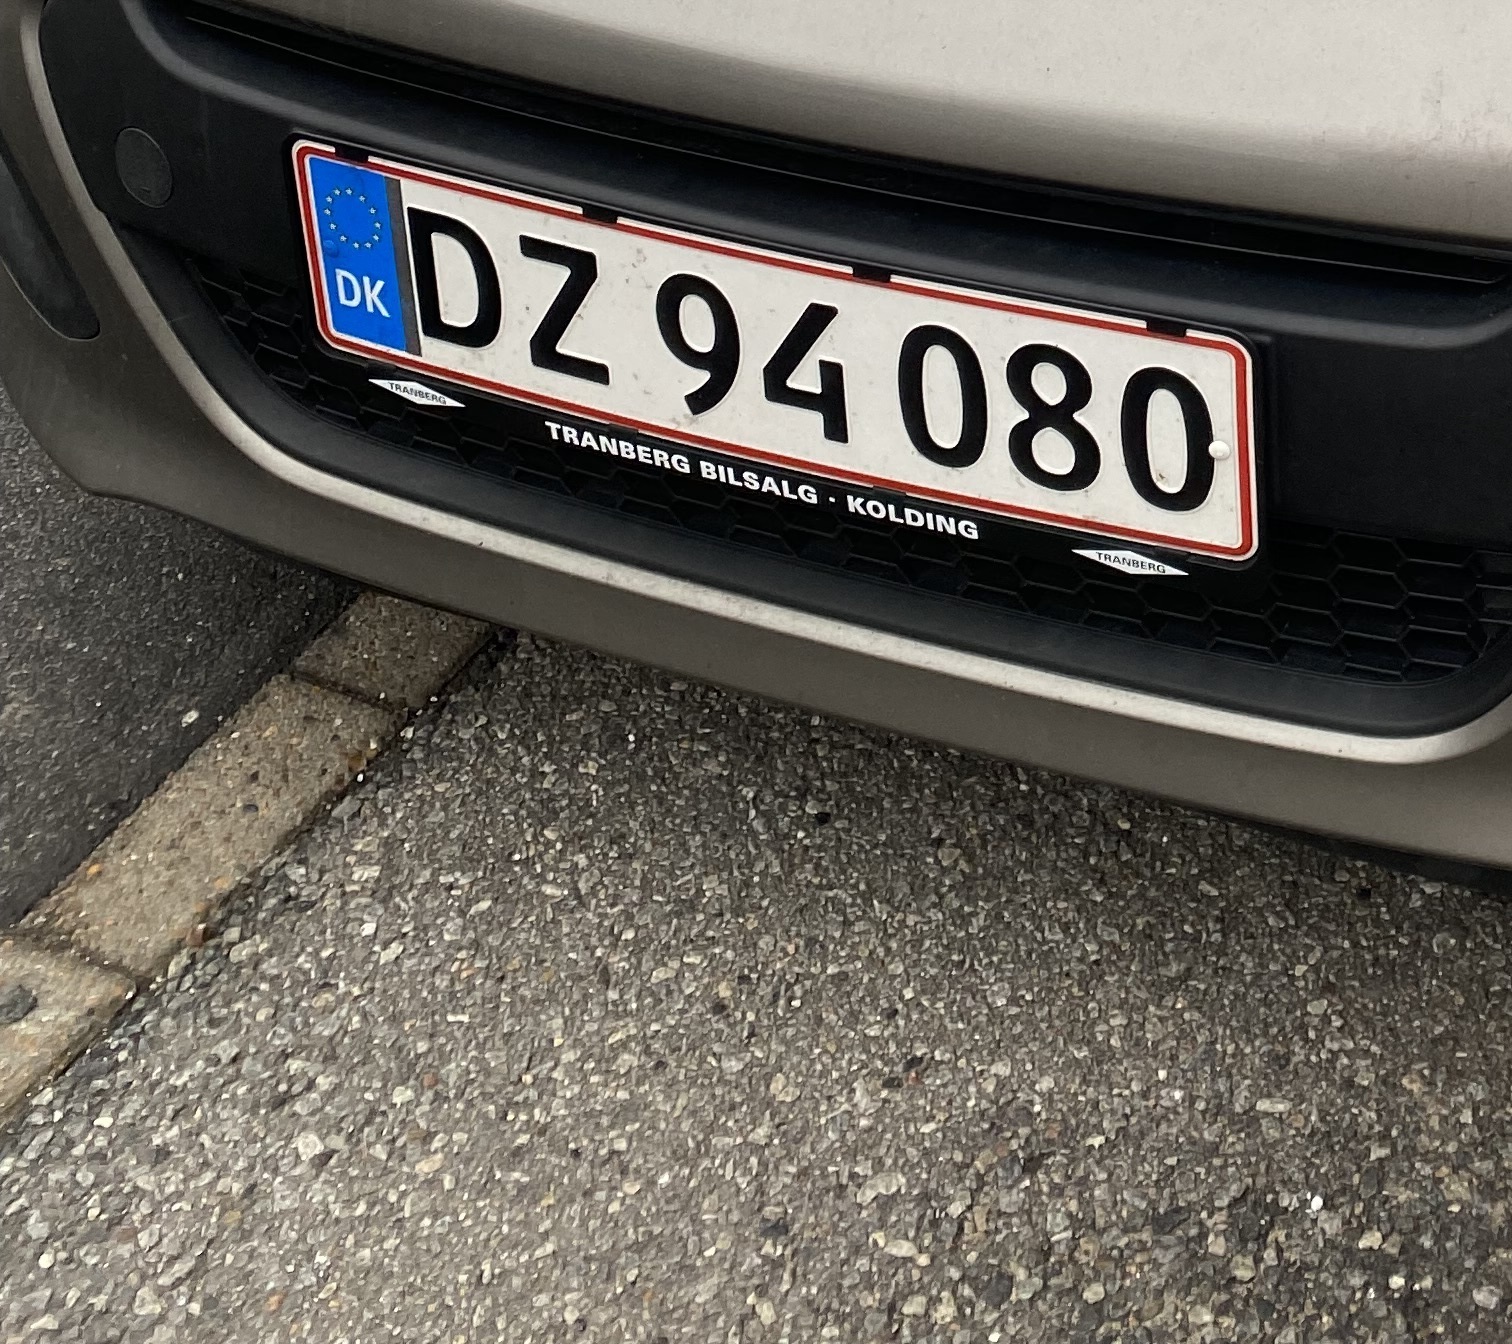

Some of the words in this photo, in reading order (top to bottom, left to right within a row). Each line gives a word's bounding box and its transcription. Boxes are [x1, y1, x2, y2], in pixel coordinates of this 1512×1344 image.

[335, 268, 391, 318] DK
[406, 206, 610, 386] DZ
[655, 272, 849, 445] 94
[899, 323, 1215, 512] 080
[388, 382, 447, 405] TRANBERG
[544, 421, 691, 474] TRANBERG
[699, 460, 818, 504] BILSALG
[846, 494, 980, 540] KOLDING
[1096, 552, 1166, 573] TRANBERG
